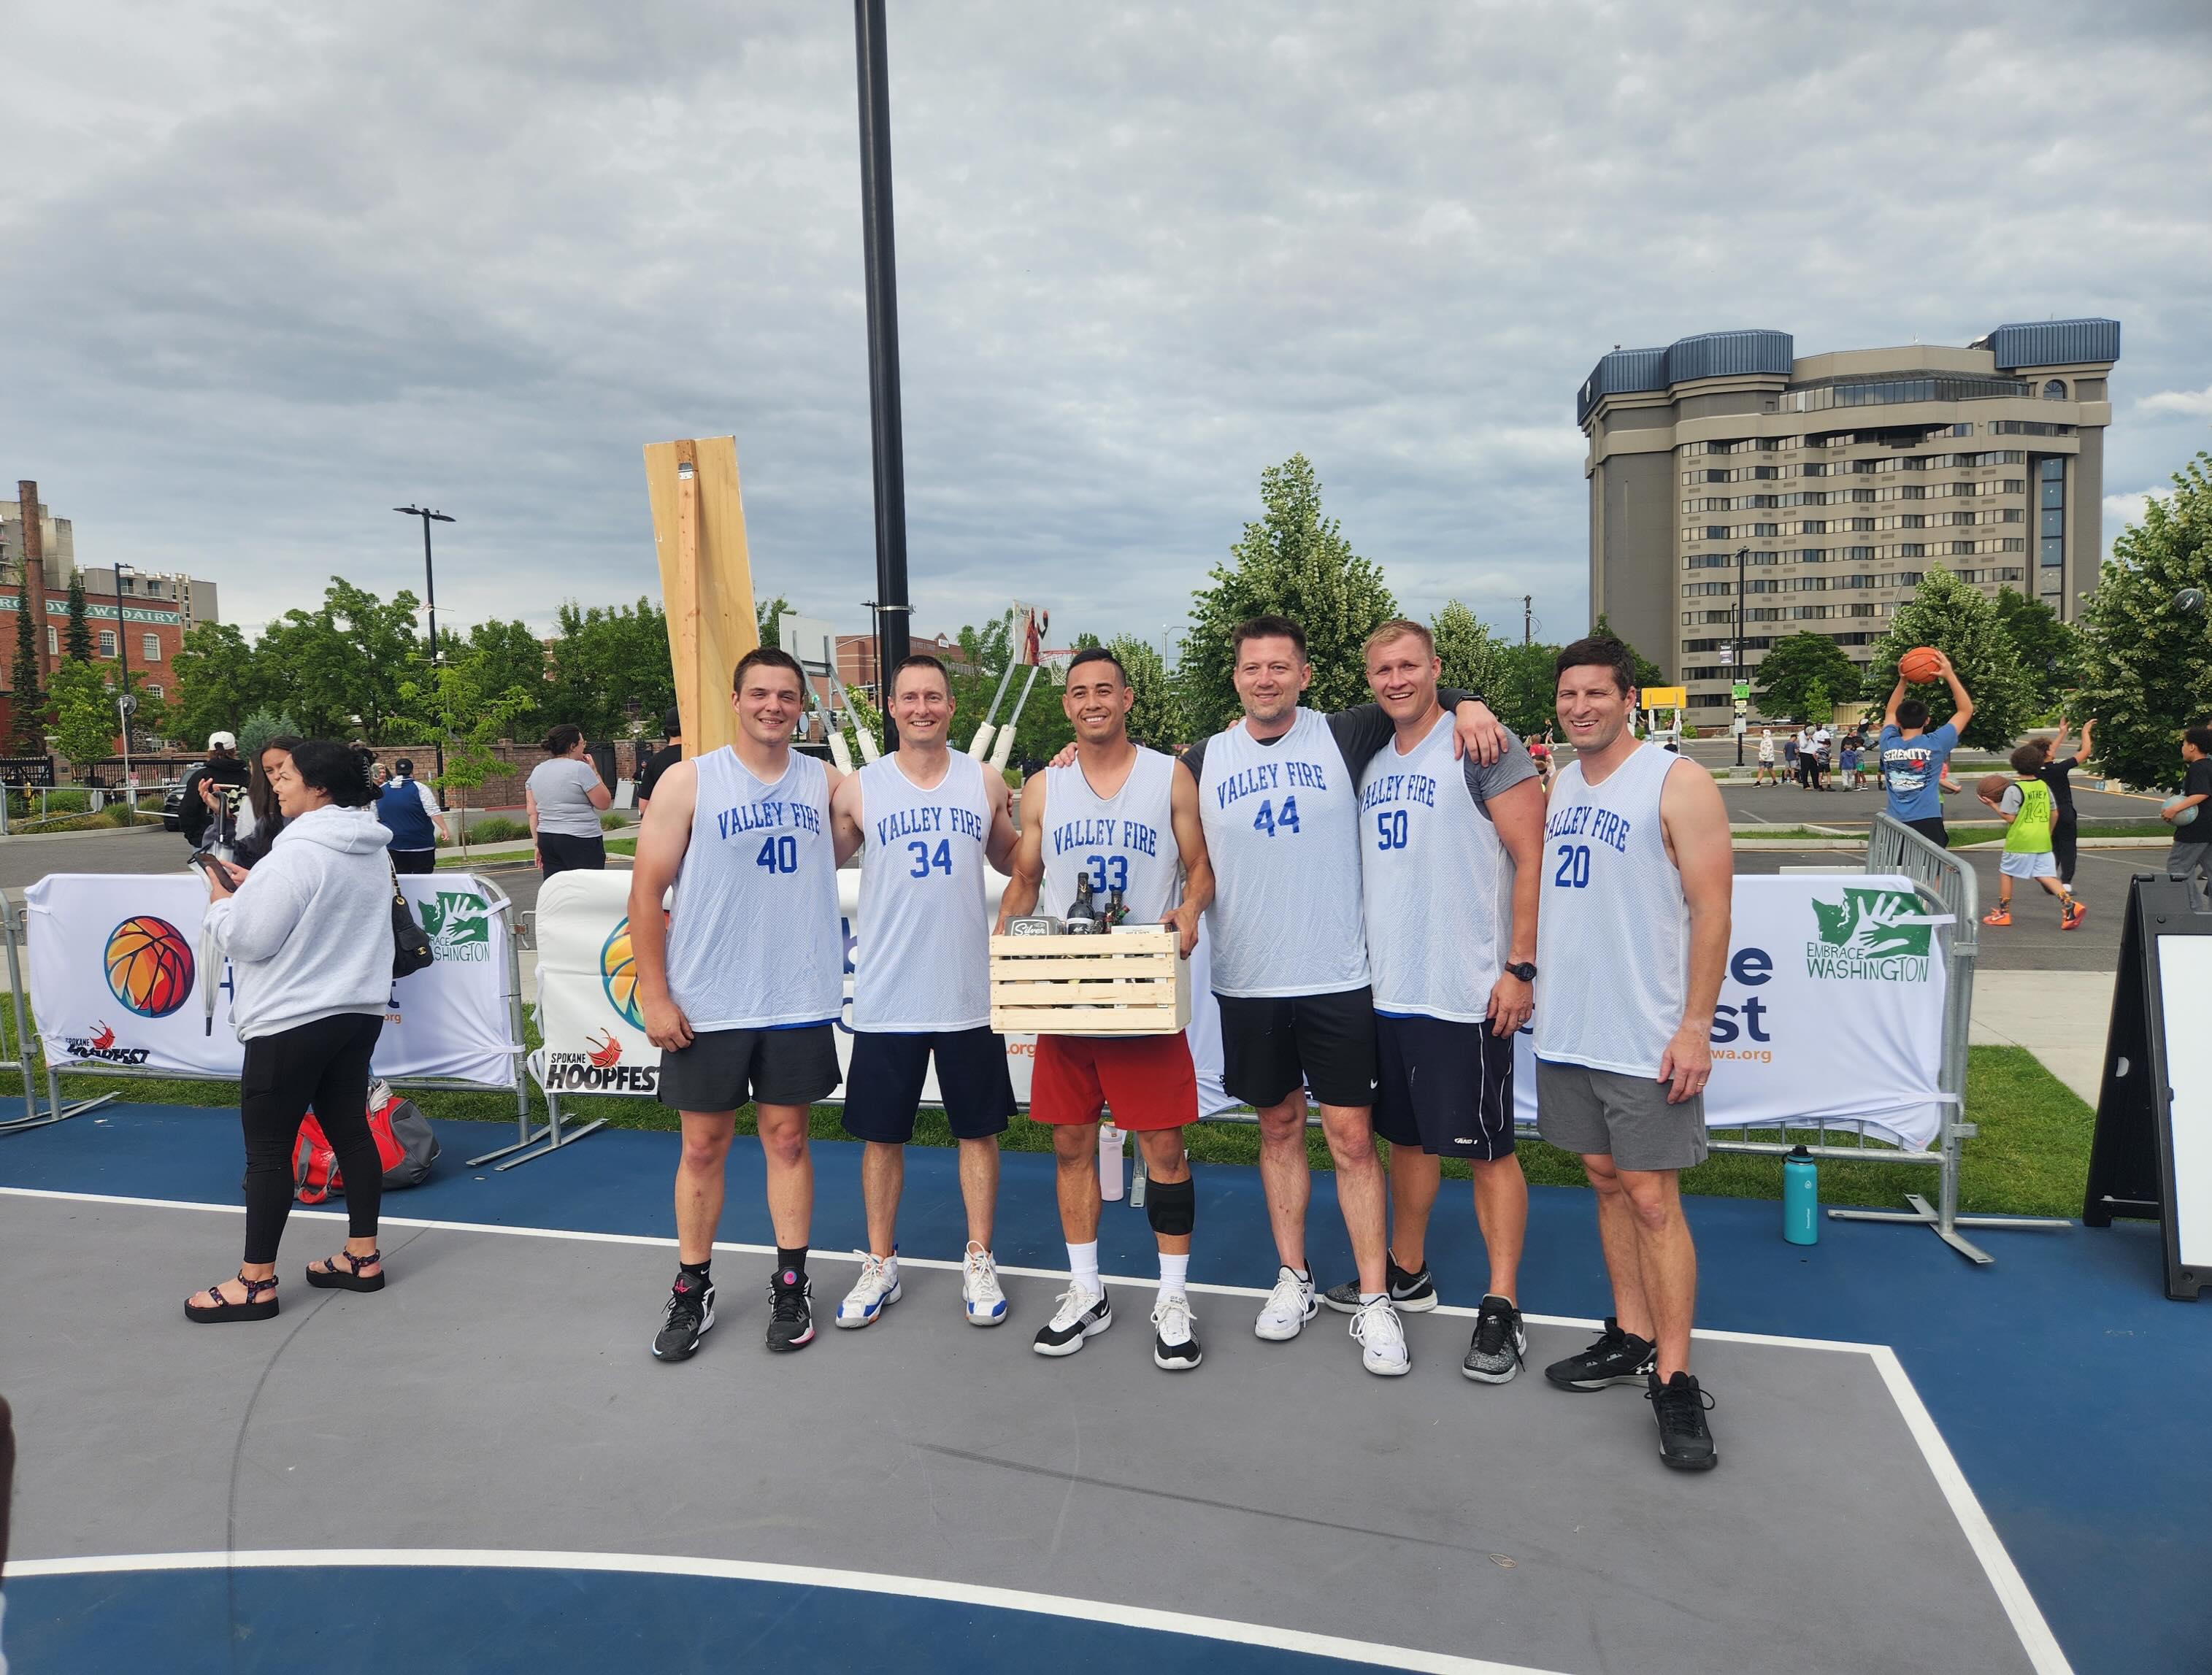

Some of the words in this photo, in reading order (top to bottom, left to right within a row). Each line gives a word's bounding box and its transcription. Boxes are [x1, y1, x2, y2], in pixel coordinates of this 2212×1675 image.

[123, 608, 177, 623] DAIRY
[1883, 748, 1932, 762] SERENITY
[1216, 763, 1278, 810] VALLEY
[1285, 761, 1326, 790] FIRE
[1359, 775, 1405, 818] VALLEY
[1407, 774, 1436, 808] FIRE
[717, 801, 783, 840] VALLEY
[790, 803, 821, 836] FIRE
[877, 806, 942, 847] VALLEY
[949, 807, 981, 842] FIRE
[1253, 795, 1299, 837] 44
[1378, 809, 1408, 850] 50
[1591, 808, 1630, 853] FIRE
[2024, 802, 2048, 823] 14
[756, 836, 797, 874] 40
[1053, 819, 1116, 855] VALLEY
[1124, 820, 1156, 858] FIRE
[907, 839, 952, 879] 34
[1086, 855, 1128, 893] 33
[1555, 844, 1590, 888] 20
[430, 936, 450, 947] RACE
[1015, 923, 1045, 936] Silver
[434, 942, 490, 961] SHINGTON
[1806, 942, 1865, 960] EMBRACE
[1807, 956, 1929, 982] WASHINGTON
[551, 1052, 585, 1063] SPOKANE
